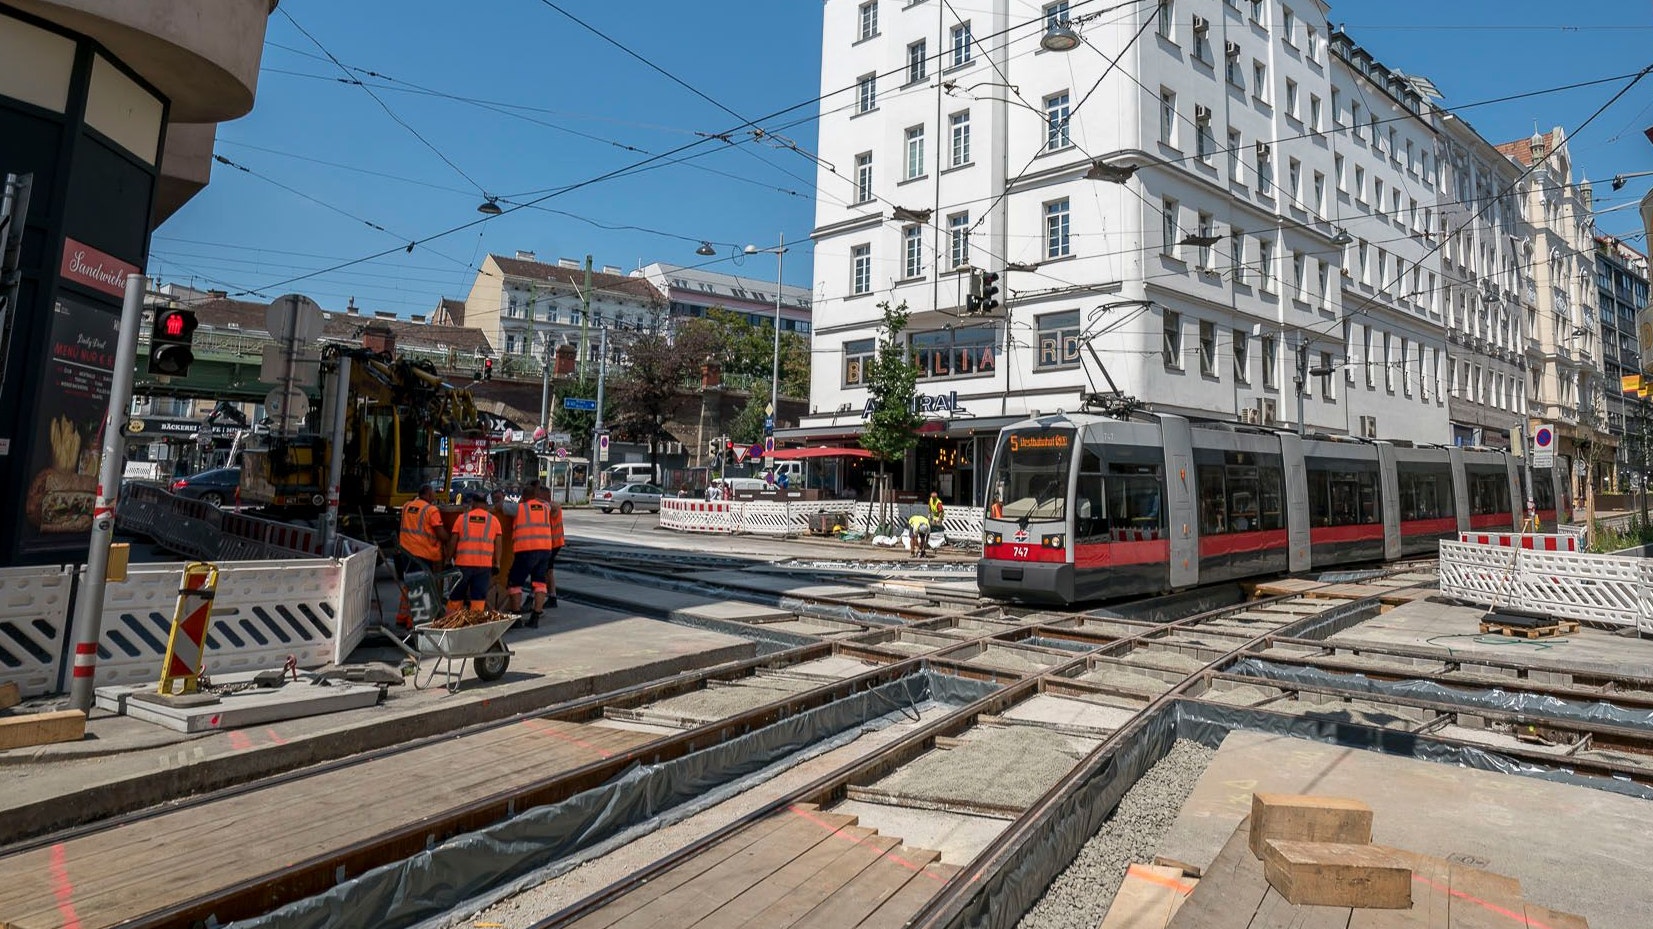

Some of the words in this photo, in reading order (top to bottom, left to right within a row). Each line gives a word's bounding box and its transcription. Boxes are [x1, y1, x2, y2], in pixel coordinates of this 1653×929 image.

[69, 250, 127, 289] Sandwiche
[862, 391, 966, 418] AIRAL
[161, 418, 197, 431] BÄCKEREI
[1013, 547, 1029, 557] 747
